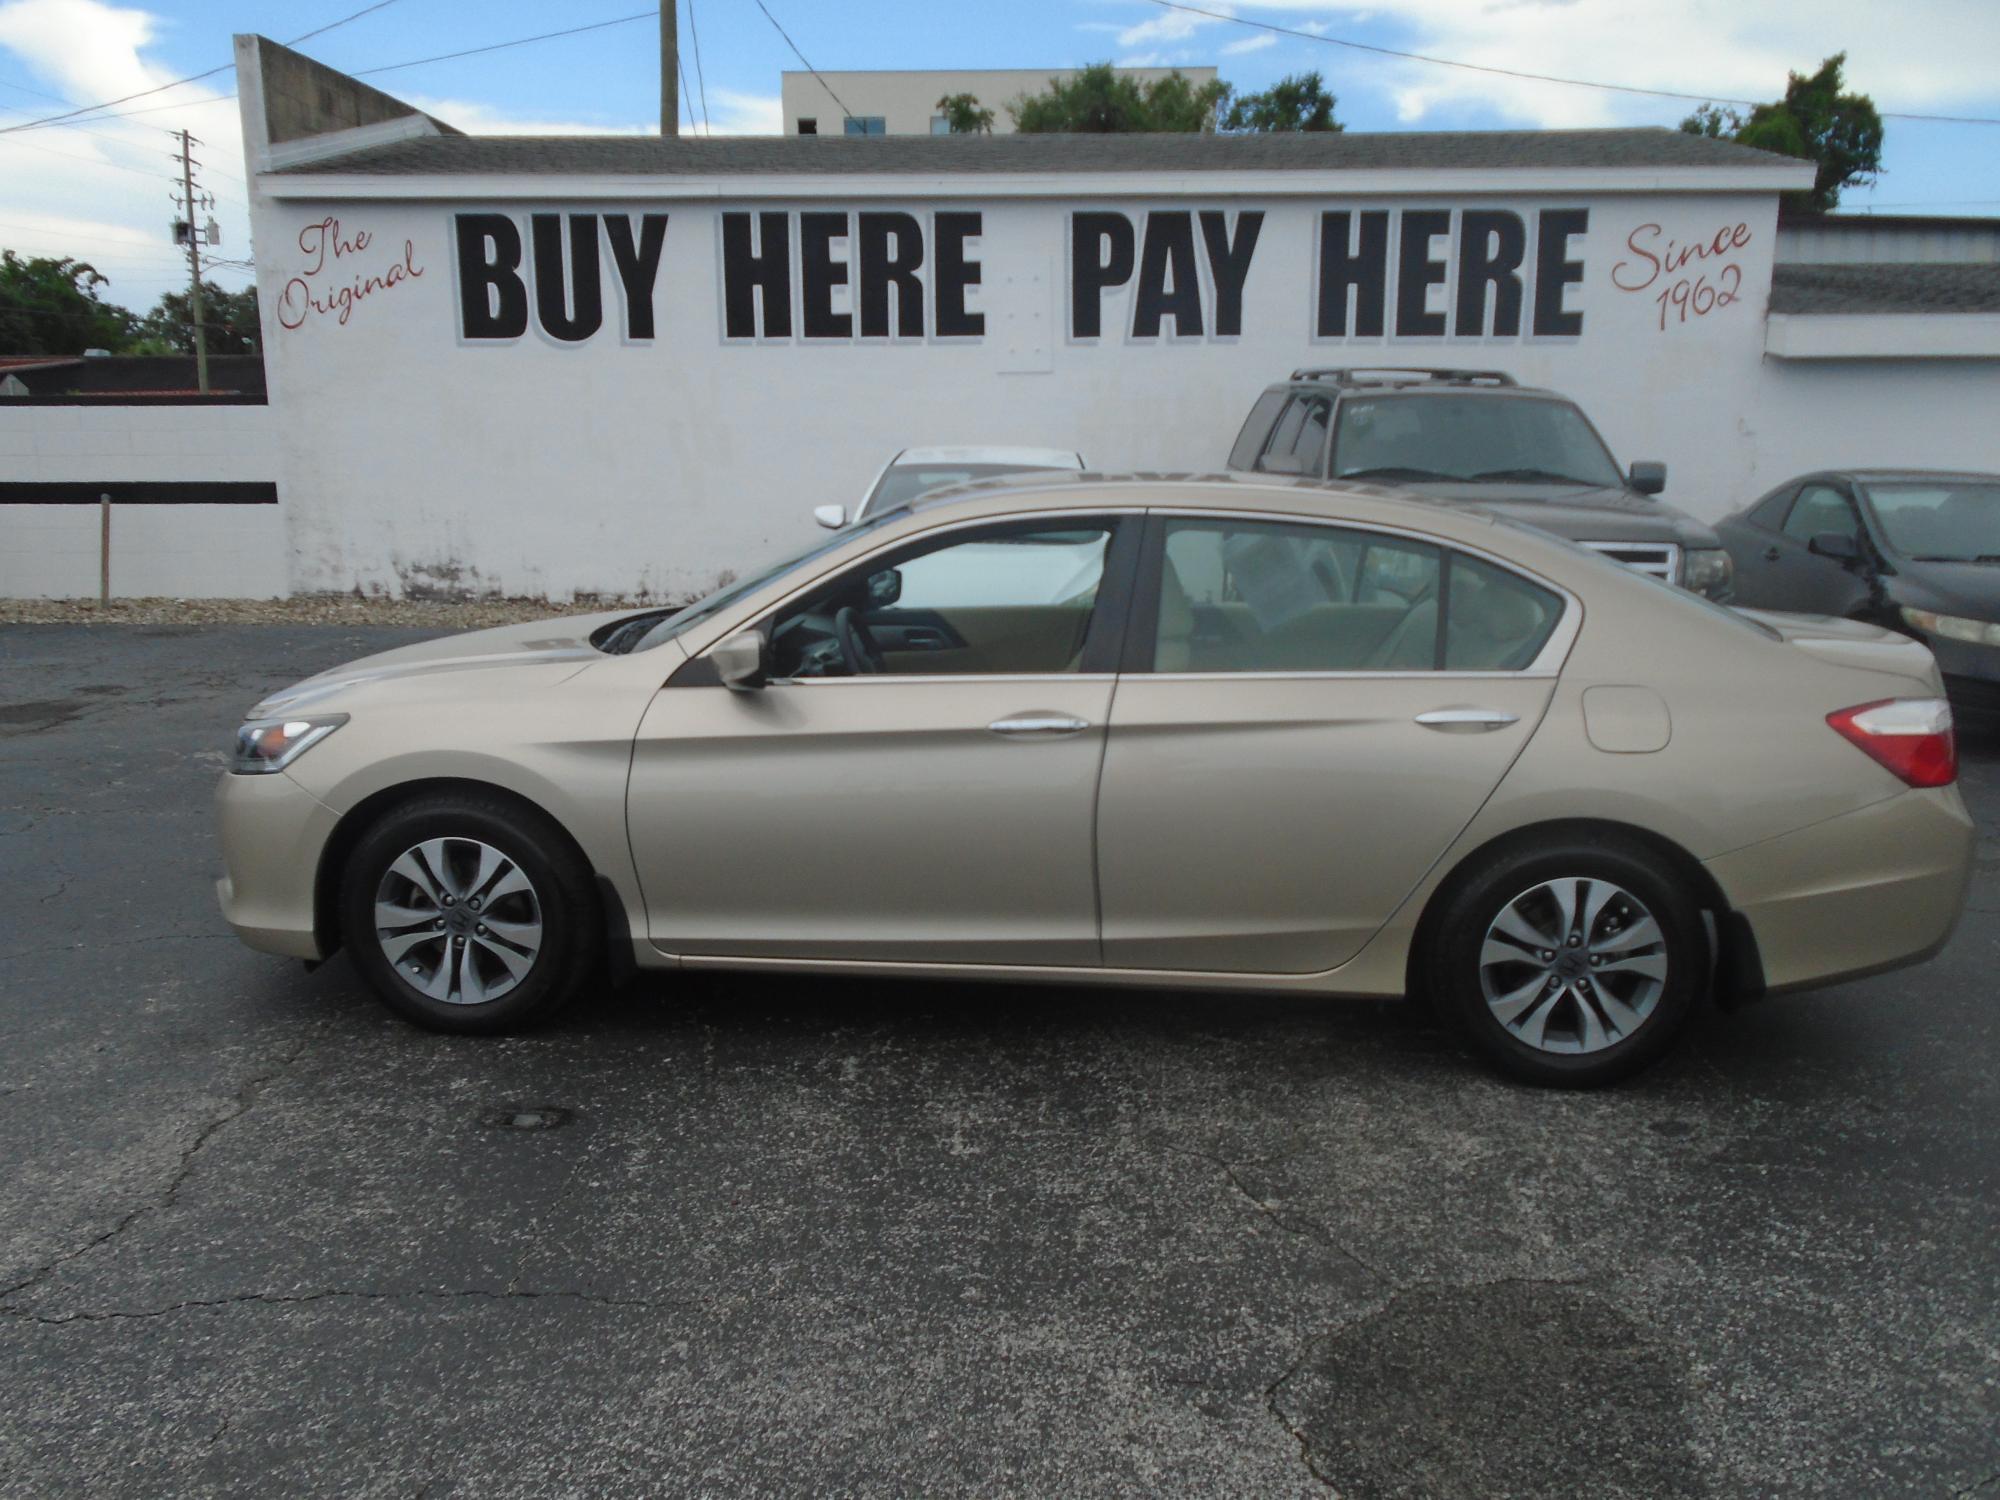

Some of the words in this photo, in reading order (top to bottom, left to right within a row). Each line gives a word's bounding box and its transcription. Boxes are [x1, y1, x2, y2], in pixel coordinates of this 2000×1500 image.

[299, 216, 373, 276] The
[455, 213, 670, 341] BUY
[722, 210, 985, 336] HERE
[1071, 209, 1266, 337] PAY
[1316, 208, 1590, 337] HERE
[1611, 222, 1752, 291] Since
[277, 239, 424, 329] Original
[1656, 264, 1742, 331] 1962
